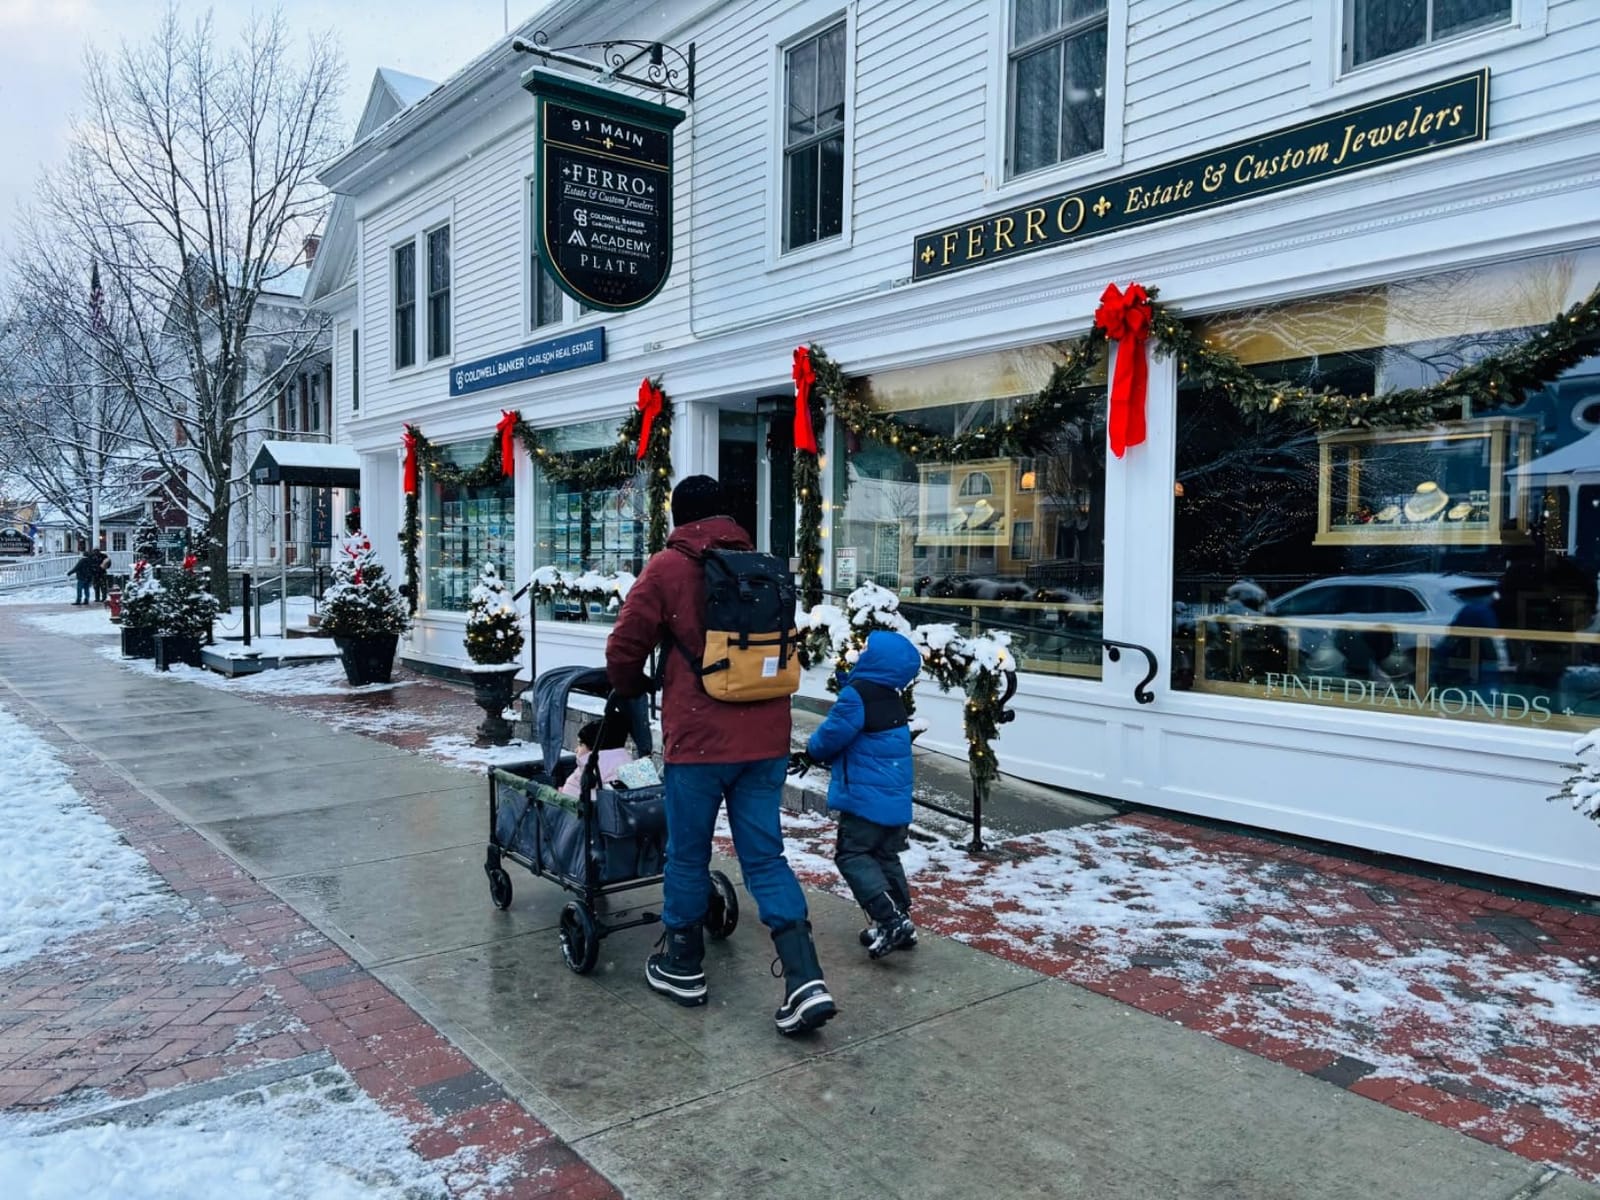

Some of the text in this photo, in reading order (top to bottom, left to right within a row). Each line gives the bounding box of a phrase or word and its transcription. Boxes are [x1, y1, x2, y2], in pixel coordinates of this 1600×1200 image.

[572, 119, 644, 147] 91 MAIN
[572, 164, 646, 195] FERRO
[940, 102, 1463, 267] FERRO Estate & Custom Jewelers
[564, 184, 587, 198] Estate
[598, 191, 625, 205] Custom
[624, 197, 654, 212] Jewelers
[590, 212, 621, 224] COLDWELL
[590, 232, 652, 254] ACADEMY
[580, 253, 638, 275] PLATE
[464, 368, 497, 384] COLDWELL
[498, 357, 525, 373] BANKER
[527, 351, 555, 366] CARLSON
[555, 346, 571, 360] REAL
[572, 340, 594, 356] ESTATE
[1264, 672, 1551, 724] FINE DIAMONDS
